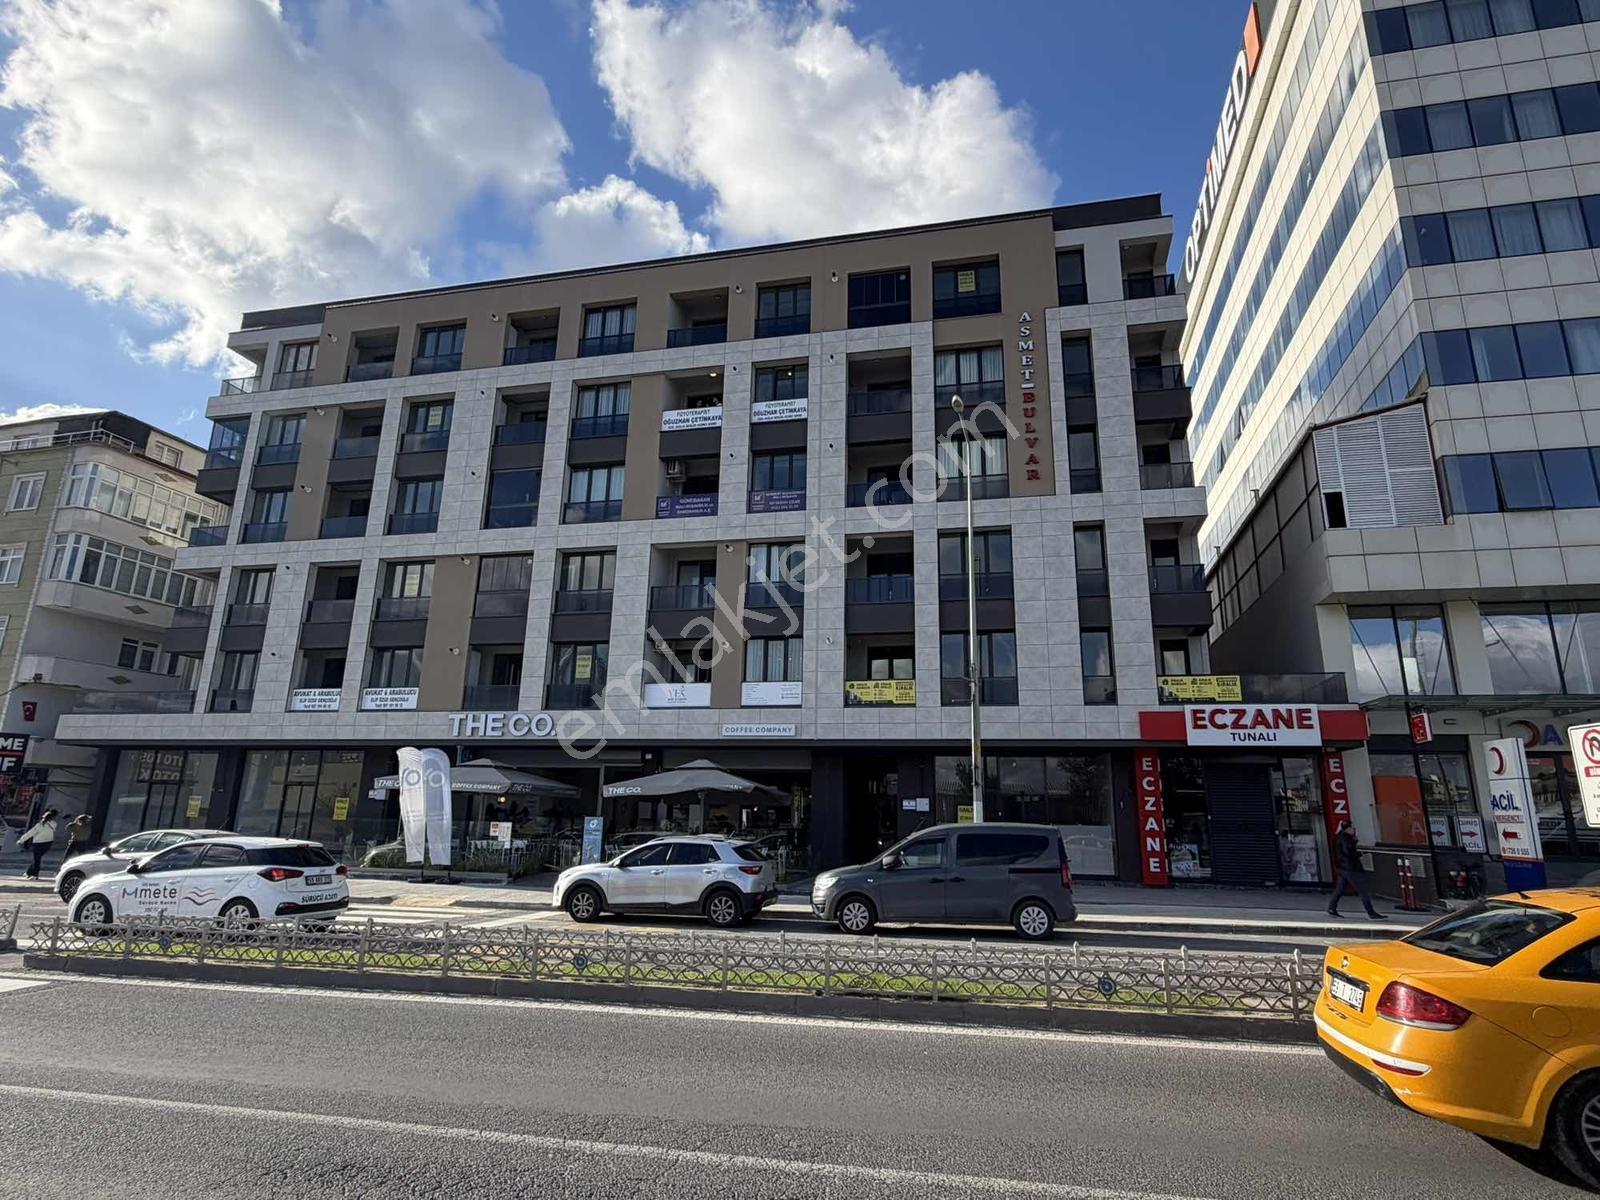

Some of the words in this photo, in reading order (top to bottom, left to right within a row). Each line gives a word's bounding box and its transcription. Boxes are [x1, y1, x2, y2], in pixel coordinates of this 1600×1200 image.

[448, 713, 505, 736] THE
[508, 713, 557, 736] CO.
[1191, 708, 1314, 730] ECZANE
[1230, 732, 1277, 742] TUNALI
[608, 787, 624, 795] THE
[1491, 790, 1521, 811] ACİL
[1142, 757, 1161, 873] ECZANE
